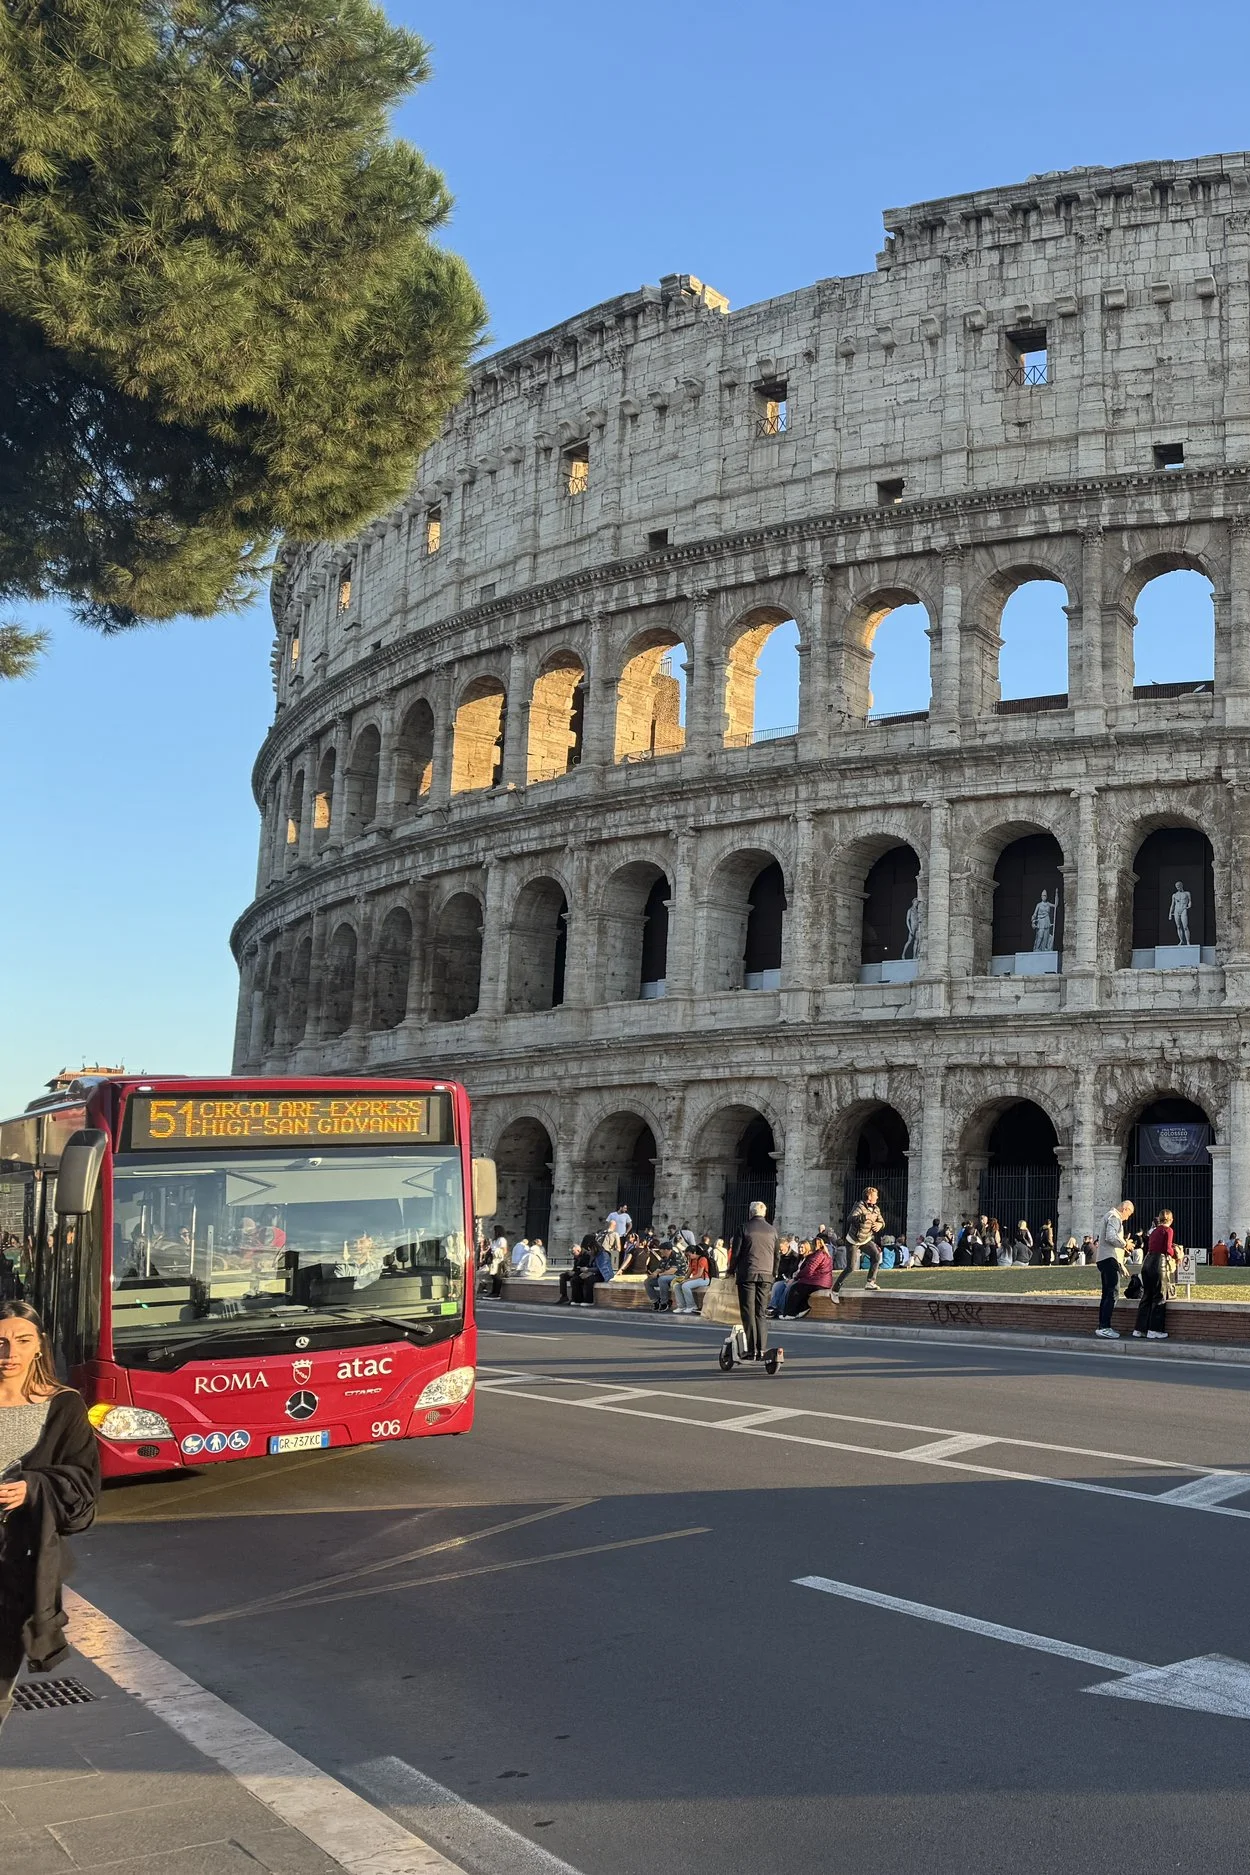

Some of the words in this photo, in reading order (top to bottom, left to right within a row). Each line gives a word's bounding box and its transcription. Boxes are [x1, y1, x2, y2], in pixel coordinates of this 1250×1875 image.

[150, 1100, 193, 1138] 51
[317, 1117, 420, 1135] GIOVANNI
[194, 1371, 269, 1394] ROMA
[336, 1357, 393, 1380] atac
[371, 1419, 401, 1438] 906
